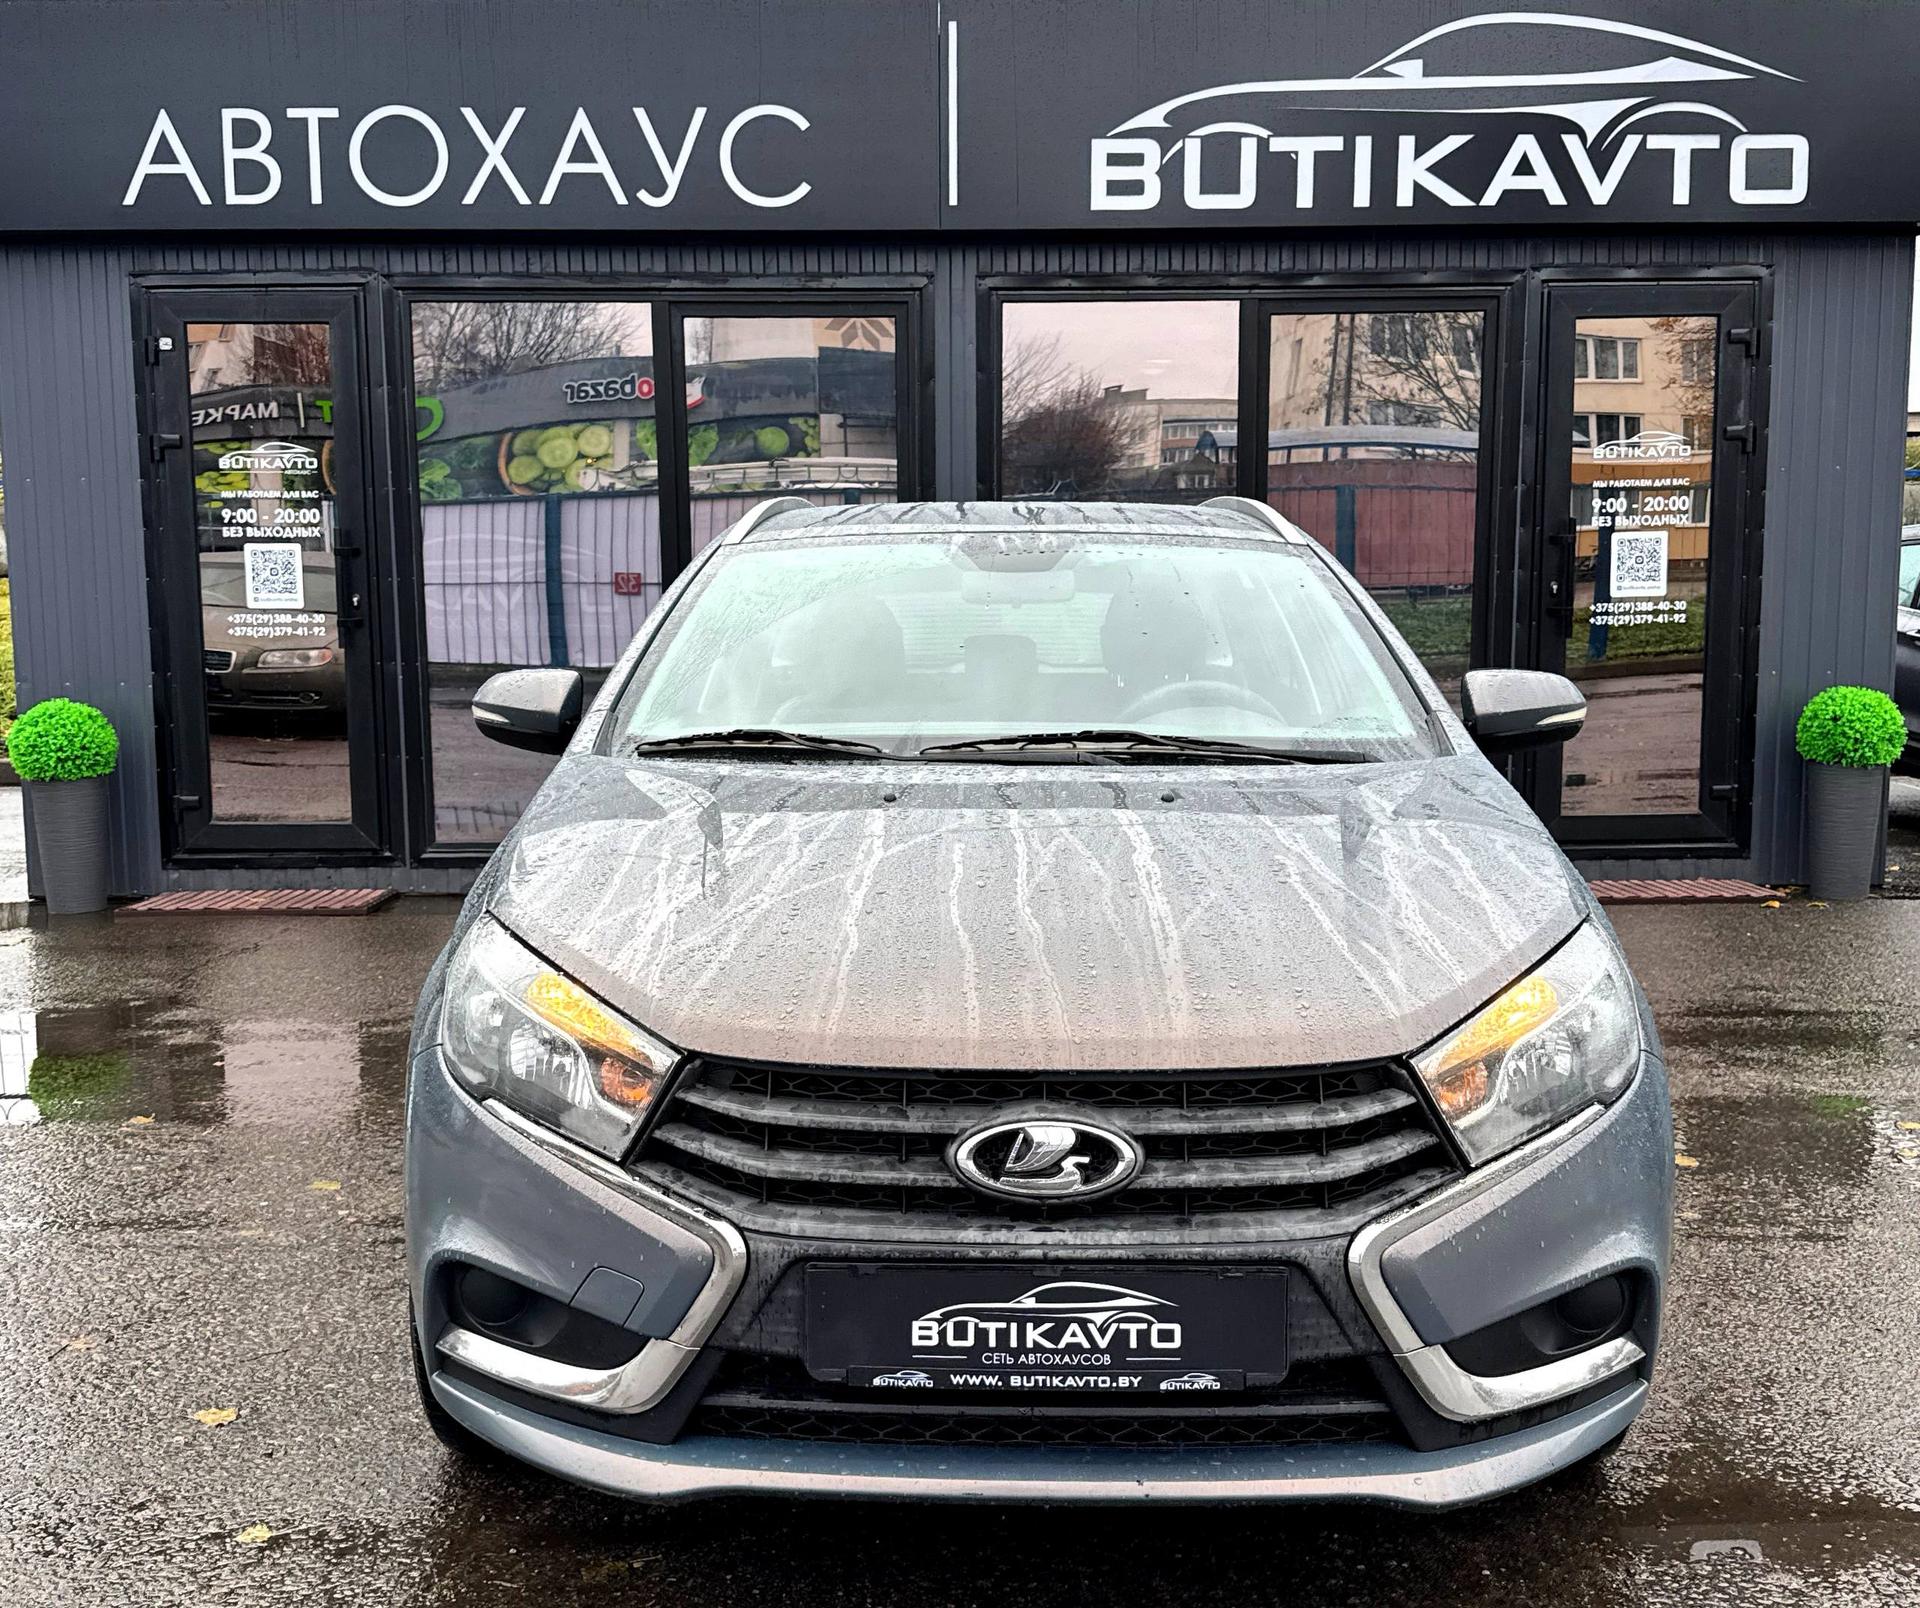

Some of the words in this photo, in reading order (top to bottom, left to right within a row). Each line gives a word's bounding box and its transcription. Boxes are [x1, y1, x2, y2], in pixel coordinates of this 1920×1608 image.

[121, 104, 812, 209] АВТОХАУС
[1089, 132, 1810, 211] BUTIKAVTO
[1593, 446, 1691, 459] BUTIKAVTO
[218, 457, 318, 469] BUTIKAVTO
[1592, 480, 1608, 488] МЫ
[1609, 479, 1652, 488] РАБОТАЕМ
[1653, 478, 1671, 487] ДЛЯ
[1672, 477, 1690, 486] ВАС
[220, 490, 237, 498] МЫ
[237, 490, 281, 498] РАБОТАЕМ
[282, 490, 300, 498] ДЛЯ
[301, 490, 319, 498] ВАС
[1591, 497, 1627, 513] 9:00
[1643, 495, 1690, 511] 20:00
[221, 508, 257, 523] 9:00
[273, 508, 321, 523] 20:00
[1591, 515, 1612, 527] БЕЗ
[1614, 514, 1689, 527] ВЫХОДНЫХ
[222, 527, 244, 538] БЕЗ
[246, 526, 321, 538] ВЫХОДНЫХ
[1589, 600, 1687, 614] +375(29)388-40-30
[227, 613, 326, 626] +375(29)388-40-30
[1589, 613, 1687, 627] +375(29)379-41-92
[227, 626, 326, 638] +375(29)379-41-92
[911, 1320, 1182, 1349] BUTIKAVTO
[981, 1353, 1015, 1364] СЕТЬ
[1017, 1353, 1112, 1366] АВТОХАУСОВ
[872, 1377, 934, 1387] BUTIKAVTO
[950, 1374, 1003, 1387] WWW.
[1010, 1375, 1143, 1388] BUTIKAVTO.BY
[1159, 1380, 1221, 1390] BUTIKAVTO
